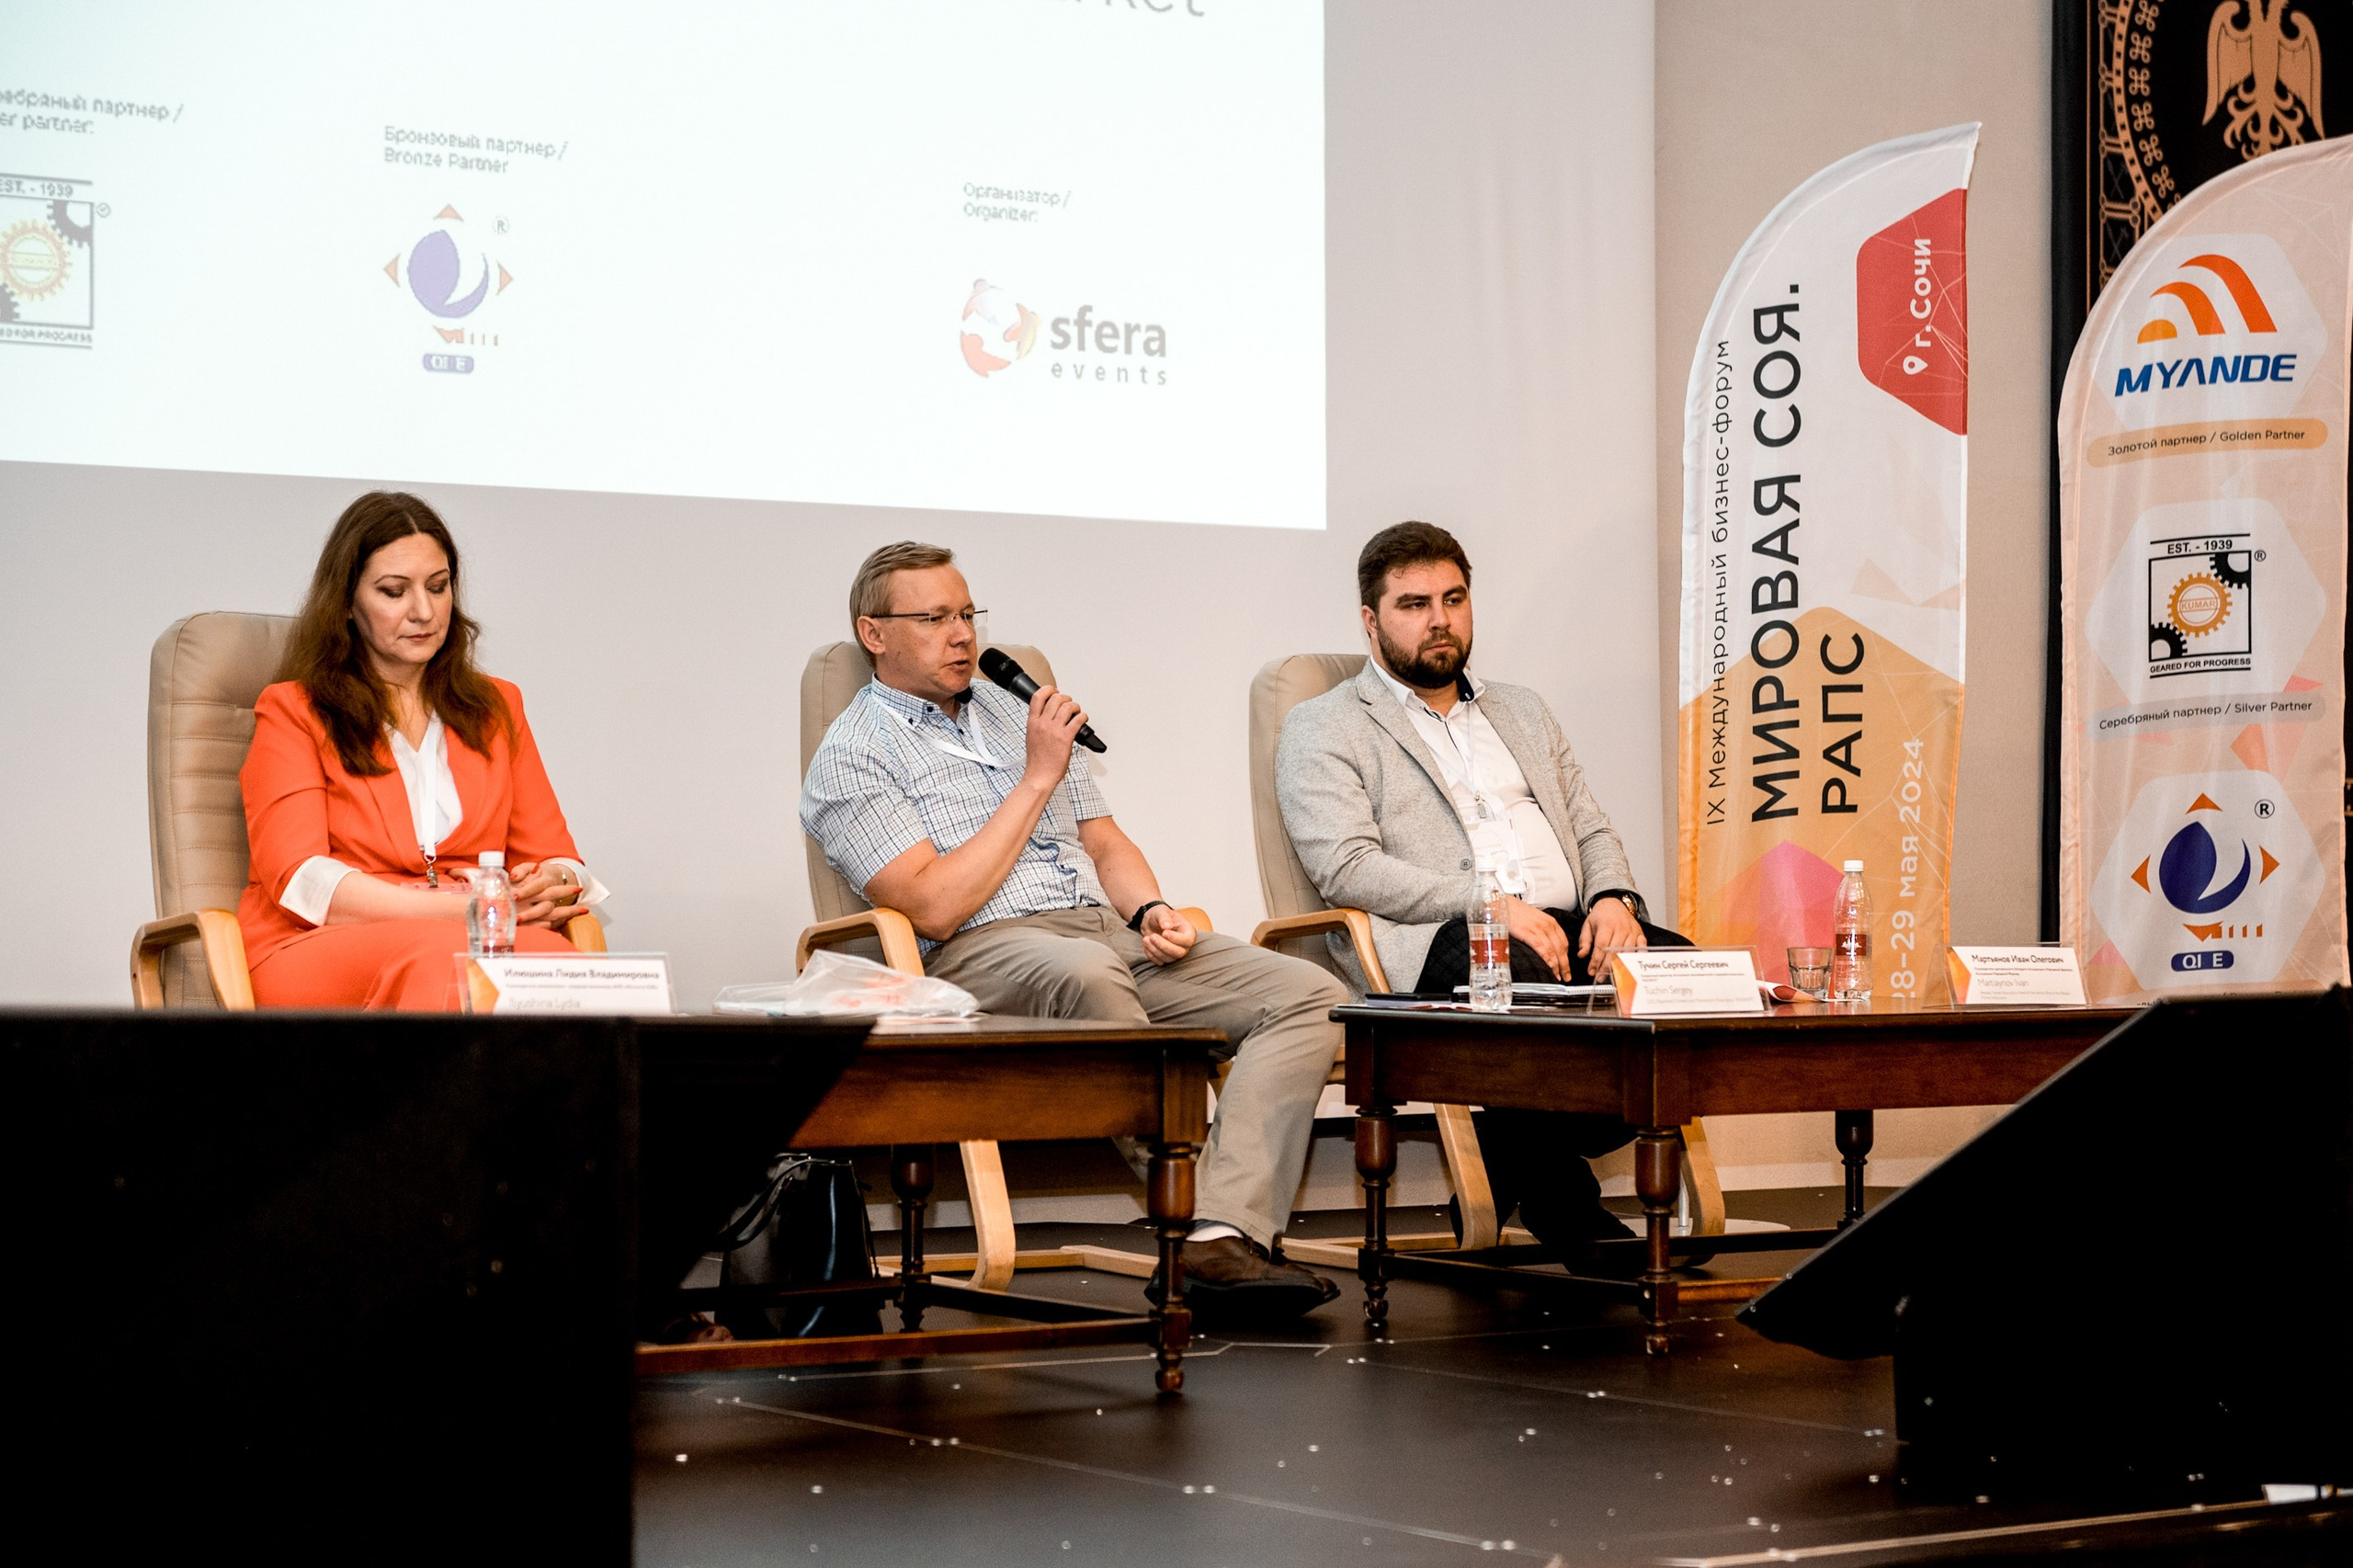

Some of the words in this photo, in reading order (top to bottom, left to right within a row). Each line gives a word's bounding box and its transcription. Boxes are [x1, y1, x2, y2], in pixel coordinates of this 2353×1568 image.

[384, 125, 481, 150] Бронзовый
[384, 147, 442, 167] Bronze
[449, 153, 509, 173] Partner
[1910, 239, 1932, 319] Сочи
[1050, 304, 1167, 358] sfera
[1051, 361, 1167, 386] events
[1753, 283, 1802, 448] СОЯ.
[2115, 354, 2297, 397] MYANDE
[1711, 340, 1733, 543] бизнес-форум
[2108, 439, 2157, 456] Золотой
[2161, 435, 2207, 447] партнер
[2220, 431, 2261, 442] Golden
[2266, 429, 2305, 440] Partner
[2167, 543, 2191, 554] EST.
[2204, 540, 2233, 551] 1939
[2181, 600, 2216, 610] KUMAR
[1751, 474, 1801, 822] МИРОВАЯ
[2150, 662, 2182, 673] GEARED
[2184, 660, 2201, 670] FOR
[2203, 657, 2251, 667] PROGRESS
[1708, 553, 1729, 789] Международный
[1820, 632, 1865, 814] РАПС
[2098, 710, 2170, 730] Серебряный
[2173, 705, 2222, 719] партнер
[2234, 701, 2267, 714] Silver
[2270, 701, 2313, 712] Partner
[1900, 738, 1924, 824] 2024
[1707, 799, 1725, 824] IX
[1899, 835, 1919, 898] мая
[1662, 960, 1688, 970] Сергей
